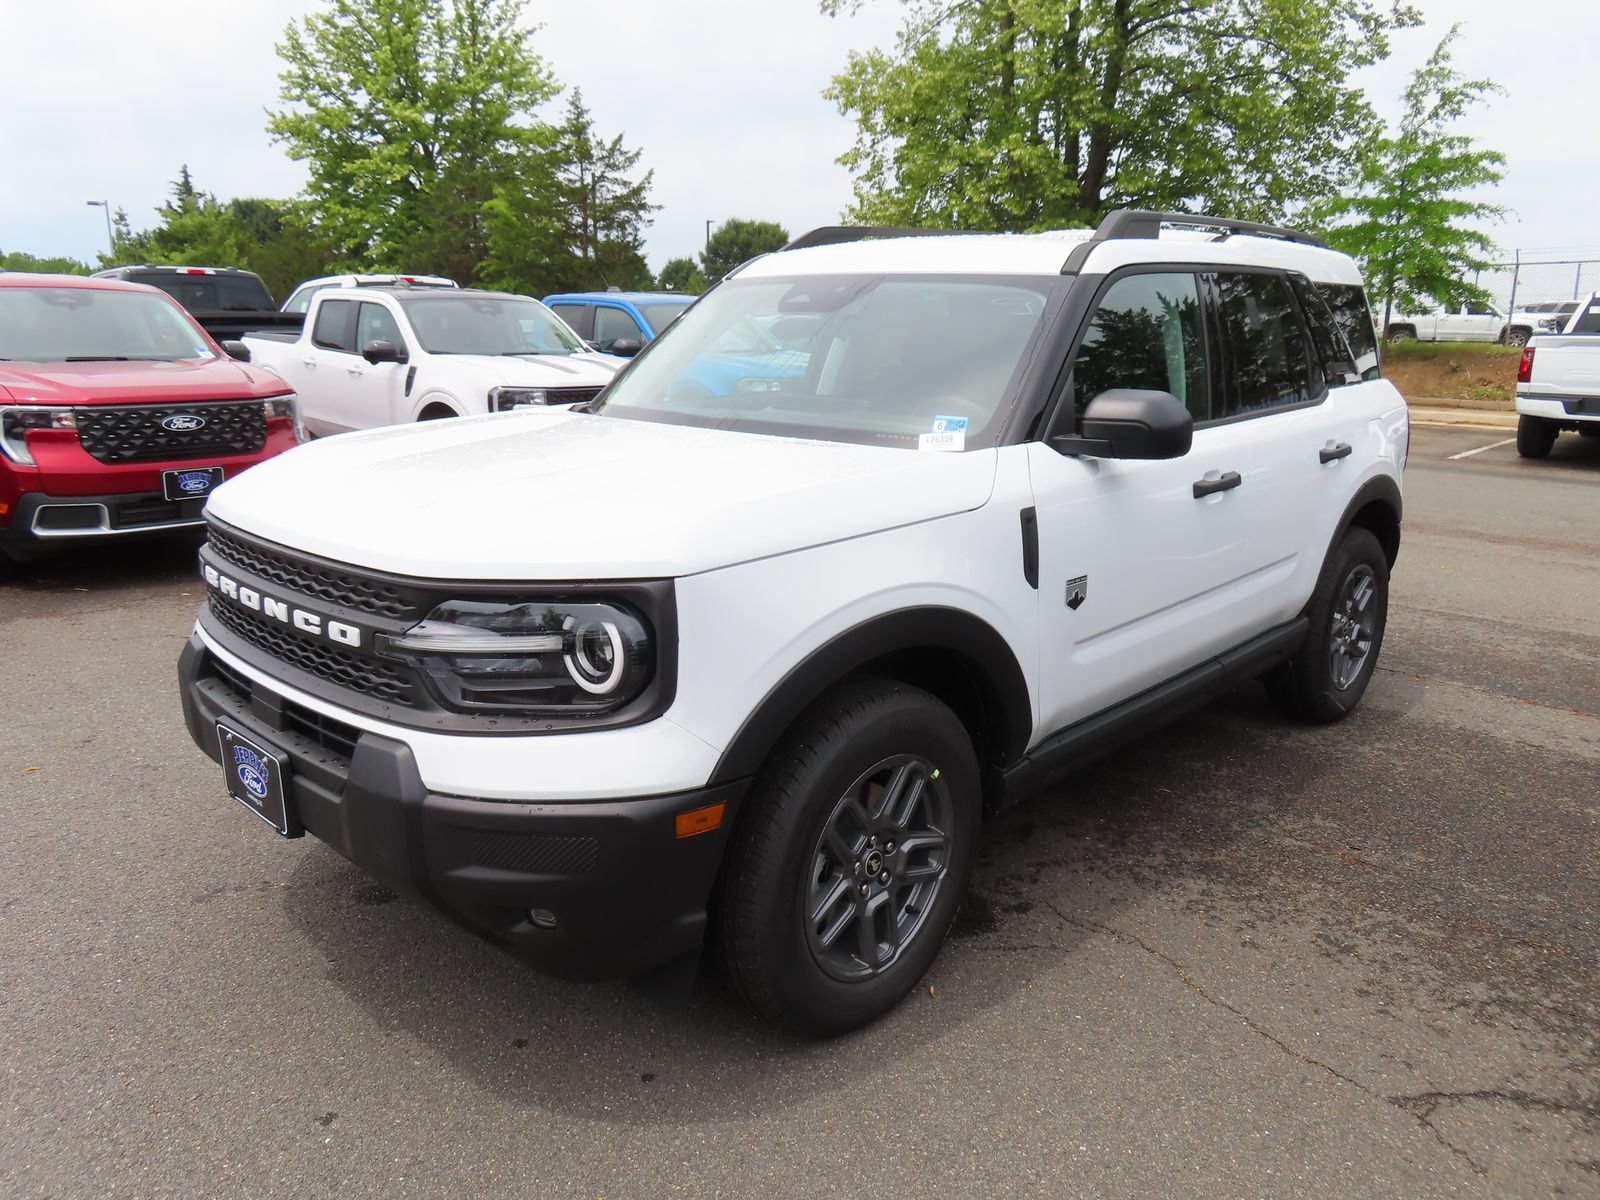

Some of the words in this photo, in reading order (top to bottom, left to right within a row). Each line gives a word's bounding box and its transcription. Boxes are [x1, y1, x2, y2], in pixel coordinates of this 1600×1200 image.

[171, 417, 197, 429] Ford
[937, 422, 944, 431] 6
[204, 565, 361, 648] BRONCO
[244, 768, 263, 793] Ford
